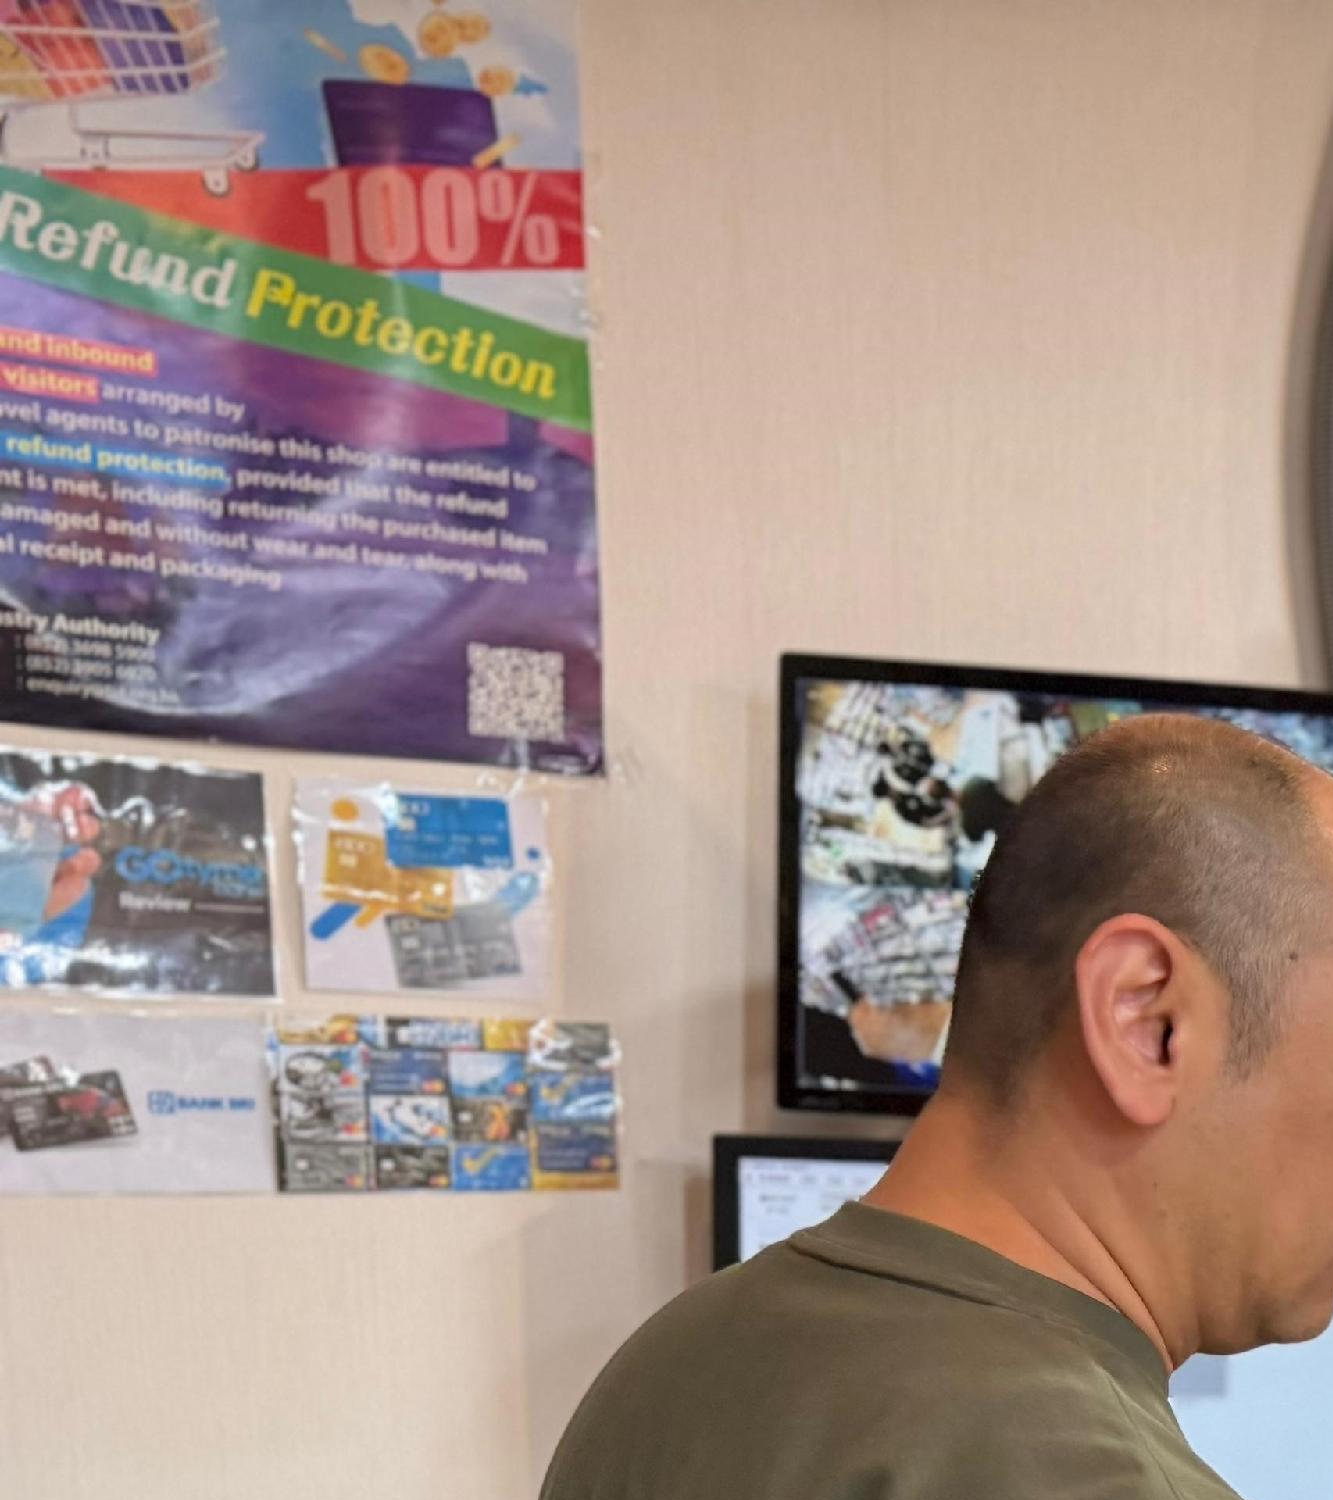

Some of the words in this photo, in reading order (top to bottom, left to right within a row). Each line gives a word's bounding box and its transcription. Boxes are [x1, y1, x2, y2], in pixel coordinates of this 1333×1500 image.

[306, 169, 560, 266] 100%
[0, 190, 238, 308] Refund
[247, 267, 558, 400] Protection
[48, 336, 154, 371] inbound
[3, 364, 97, 398] visitors
[102, 383, 210, 414] arranged
[215, 396, 245, 422] by
[6, 434, 92, 463] refund
[97, 449, 232, 484] protection,
[236, 468, 340, 497] provided
[395, 485, 432, 508] the
[436, 491, 509, 519] refund
[46, 408, 129, 436] agents
[133, 419, 159, 440] to
[164, 426, 274, 456] patronise
[279, 437, 322, 462] this
[327, 444, 383, 471] shop
[388, 457, 423, 475] are
[425, 459, 510, 488] entitled
[513, 472, 538, 492] to
[27, 468, 47, 490] is
[52, 475, 109, 501] met,
[112, 482, 225, 518] including
[227, 499, 338, 532] returning
[340, 513, 380, 534] the
[383, 519, 497, 548] purchased
[501, 530, 548, 555] item
[20, 540, 104, 568] receipt
[109, 552, 156, 573] and
[160, 557, 282, 592] packaging
[104, 517, 151, 539] and
[154, 521, 249, 551] without
[253, 535, 307, 557] wear
[313, 542, 358, 563] and
[413, 553, 478, 583] along
[479, 563, 528, 585] with
[54, 613, 160, 647] Authority
